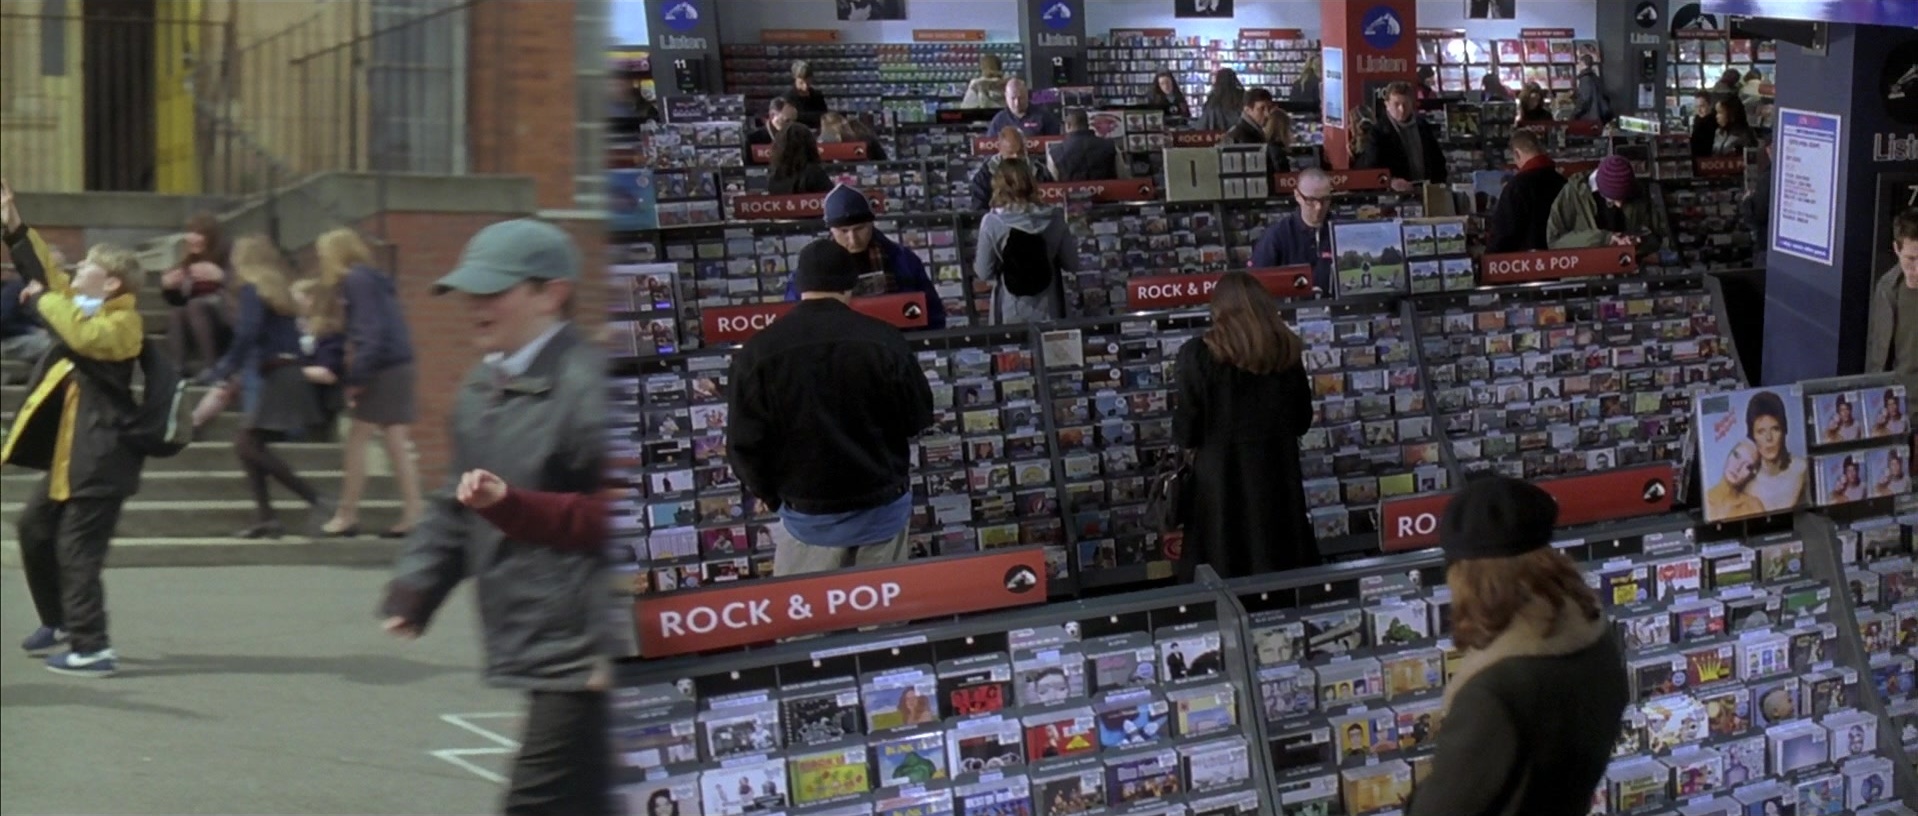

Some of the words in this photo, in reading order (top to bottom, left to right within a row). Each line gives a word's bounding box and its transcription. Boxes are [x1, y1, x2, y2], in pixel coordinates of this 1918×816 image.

[659, 34, 708, 49] Listen
[1038, 32, 1078, 47] Listen
[674, 59, 687, 69] 11
[1052, 56, 1063, 67] 12
[1356, 54, 1408, 73] Listen
[1873, 132, 1918, 161] List
[741, 201, 781, 213] ROCK
[786, 200, 796, 211] &
[1489, 259, 1530, 274] ROCK
[1535, 258, 1545, 271] &
[1550, 256, 1579, 270] POP
[1137, 284, 1182, 299] ROCK
[1187, 282, 1199, 296] &
[1398, 512, 1437, 538] RO
[659, 598, 773, 638] ROCK
[787, 594, 814, 620] &
[826, 582, 901, 614] POP
